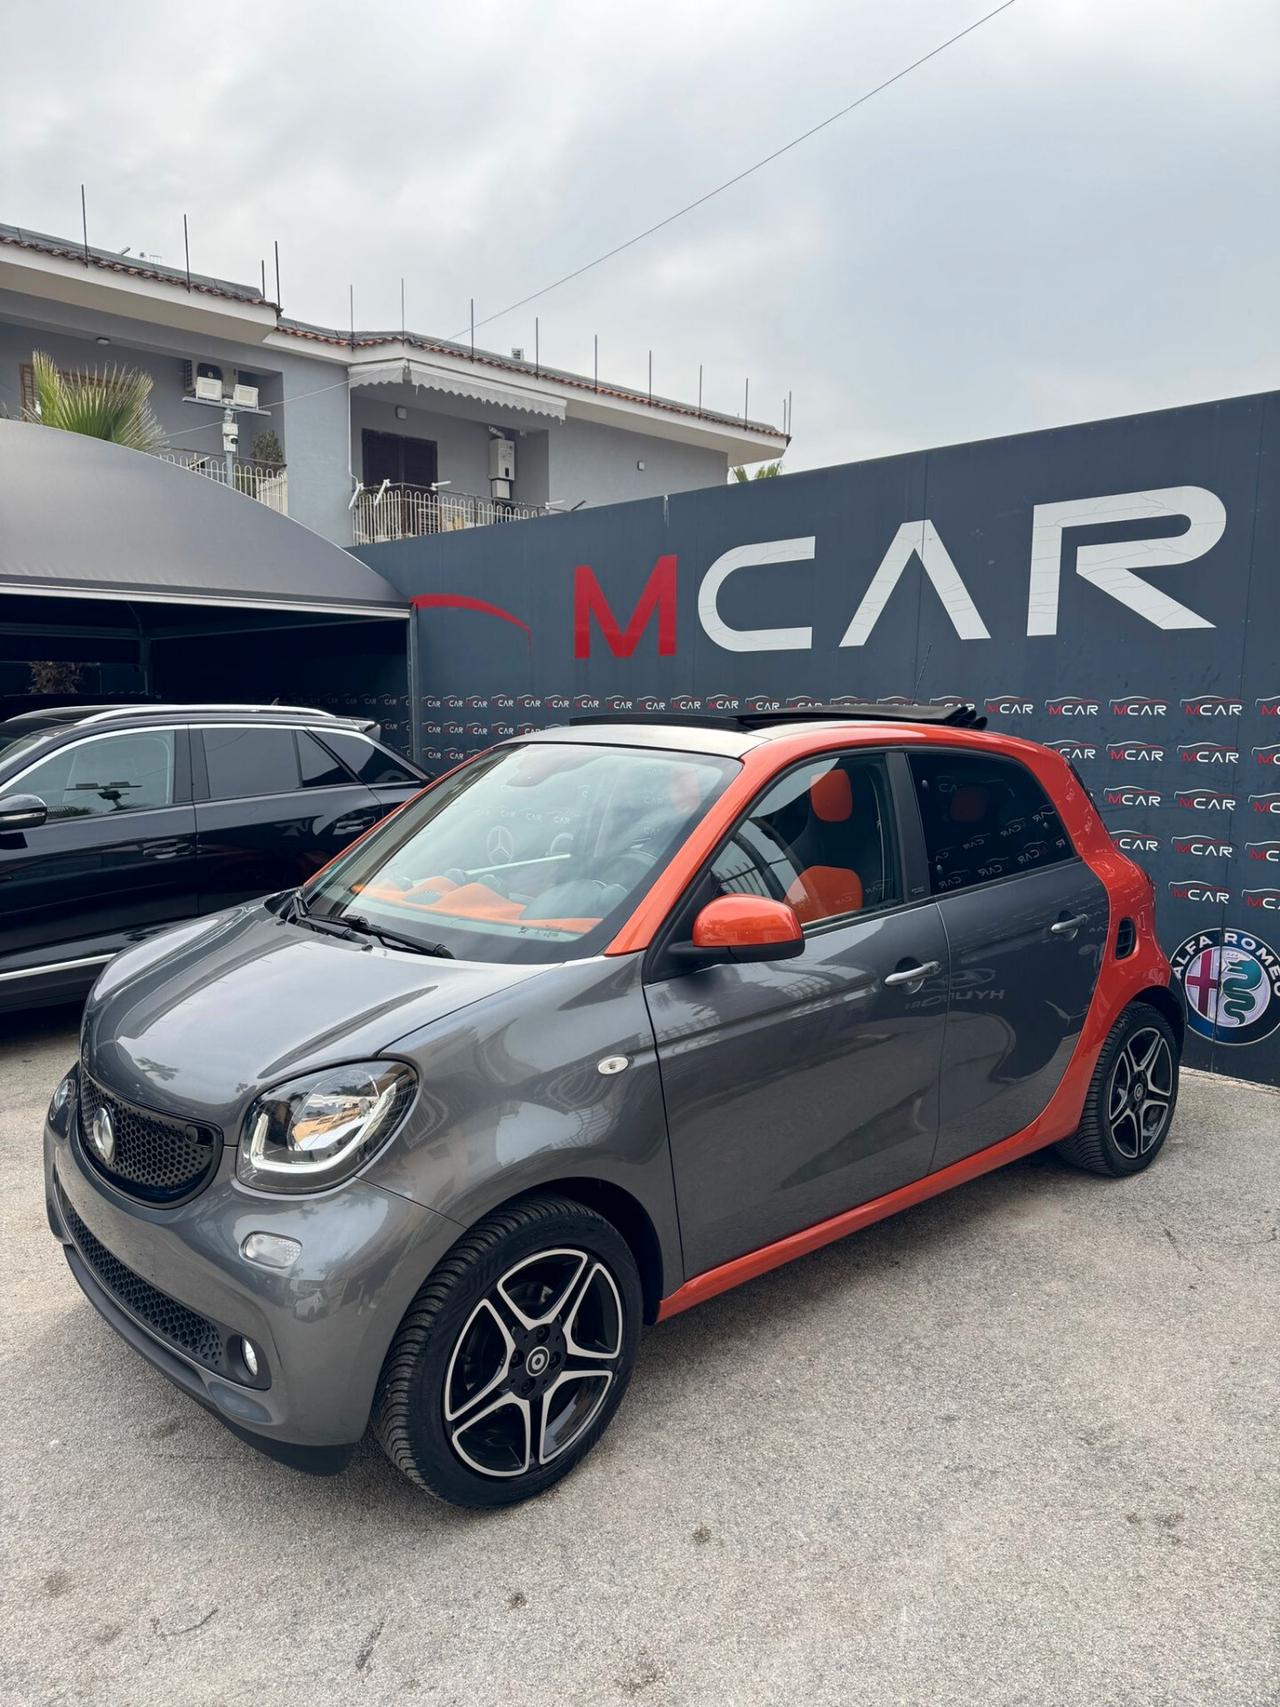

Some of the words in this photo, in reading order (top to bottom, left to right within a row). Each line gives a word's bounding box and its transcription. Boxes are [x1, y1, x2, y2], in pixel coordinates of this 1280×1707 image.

[573, 485, 1227, 659] MCAR
[1048, 704, 1099, 716] MCAR
[1113, 703, 1168, 716] MCAR
[1184, 703, 1243, 716] MCAR
[1057, 748, 1097, 760] CAR
[1111, 750, 1165, 762] MCAR
[1182, 751, 1240, 764] MCAR
[1107, 793, 1161, 807] MCAR
[1179, 796, 1237, 811] MCAR
[1174, 841, 1233, 858] MCAR
[1172, 886, 1230, 905] MCAR
[1246, 895, 1280, 911] MC
[1173, 935, 1213, 981] ALFA
